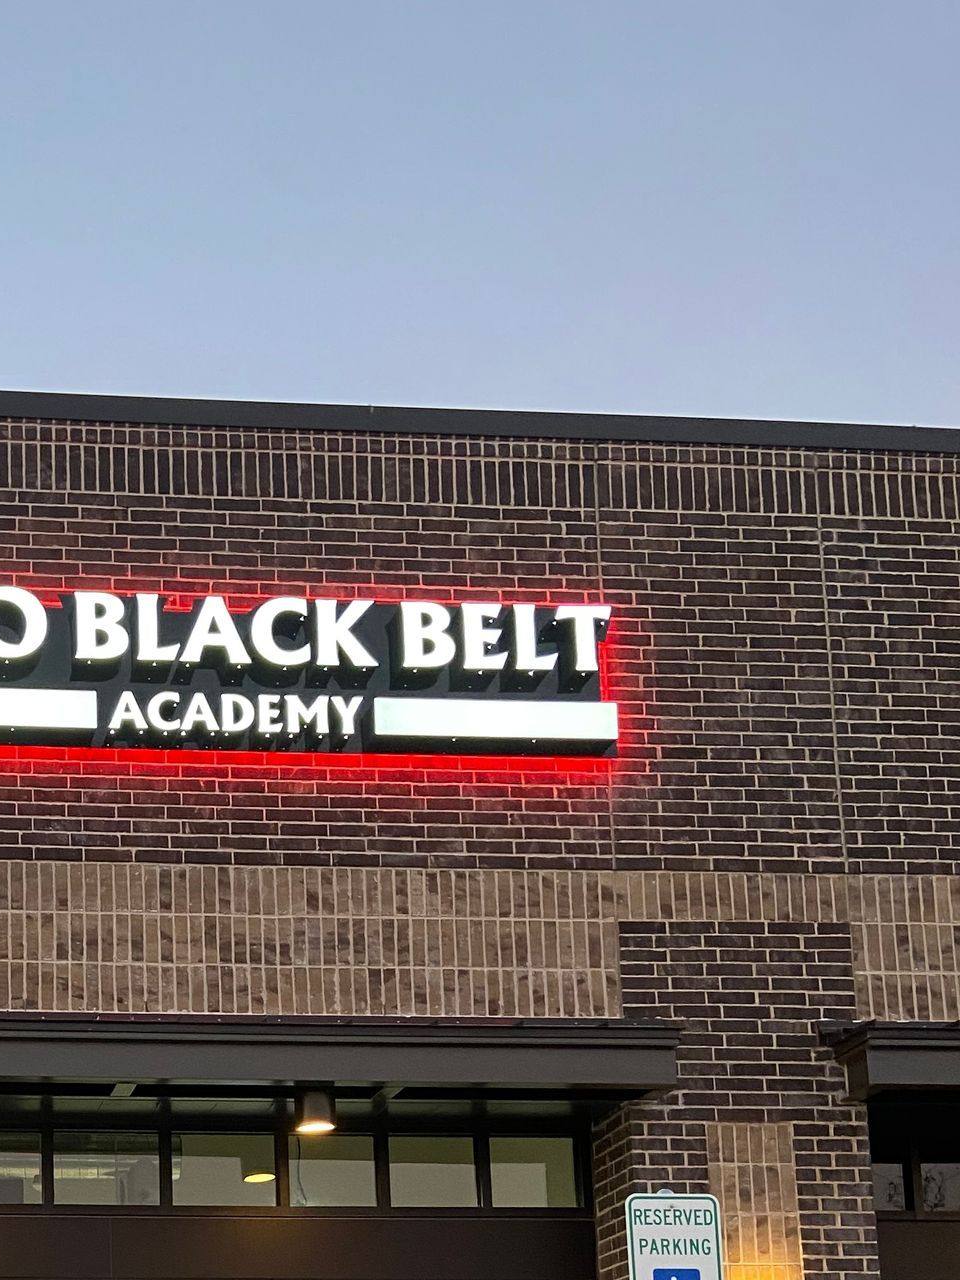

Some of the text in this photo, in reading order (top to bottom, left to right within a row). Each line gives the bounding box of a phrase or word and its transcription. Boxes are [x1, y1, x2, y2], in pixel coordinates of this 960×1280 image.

[74, 591, 379, 668] BLACK
[401, 602, 613, 673] BELT
[109, 690, 365, 736] ACADEMY
[633, 1208, 713, 1226] RESERVED
[639, 1238, 711, 1256] PARKING
